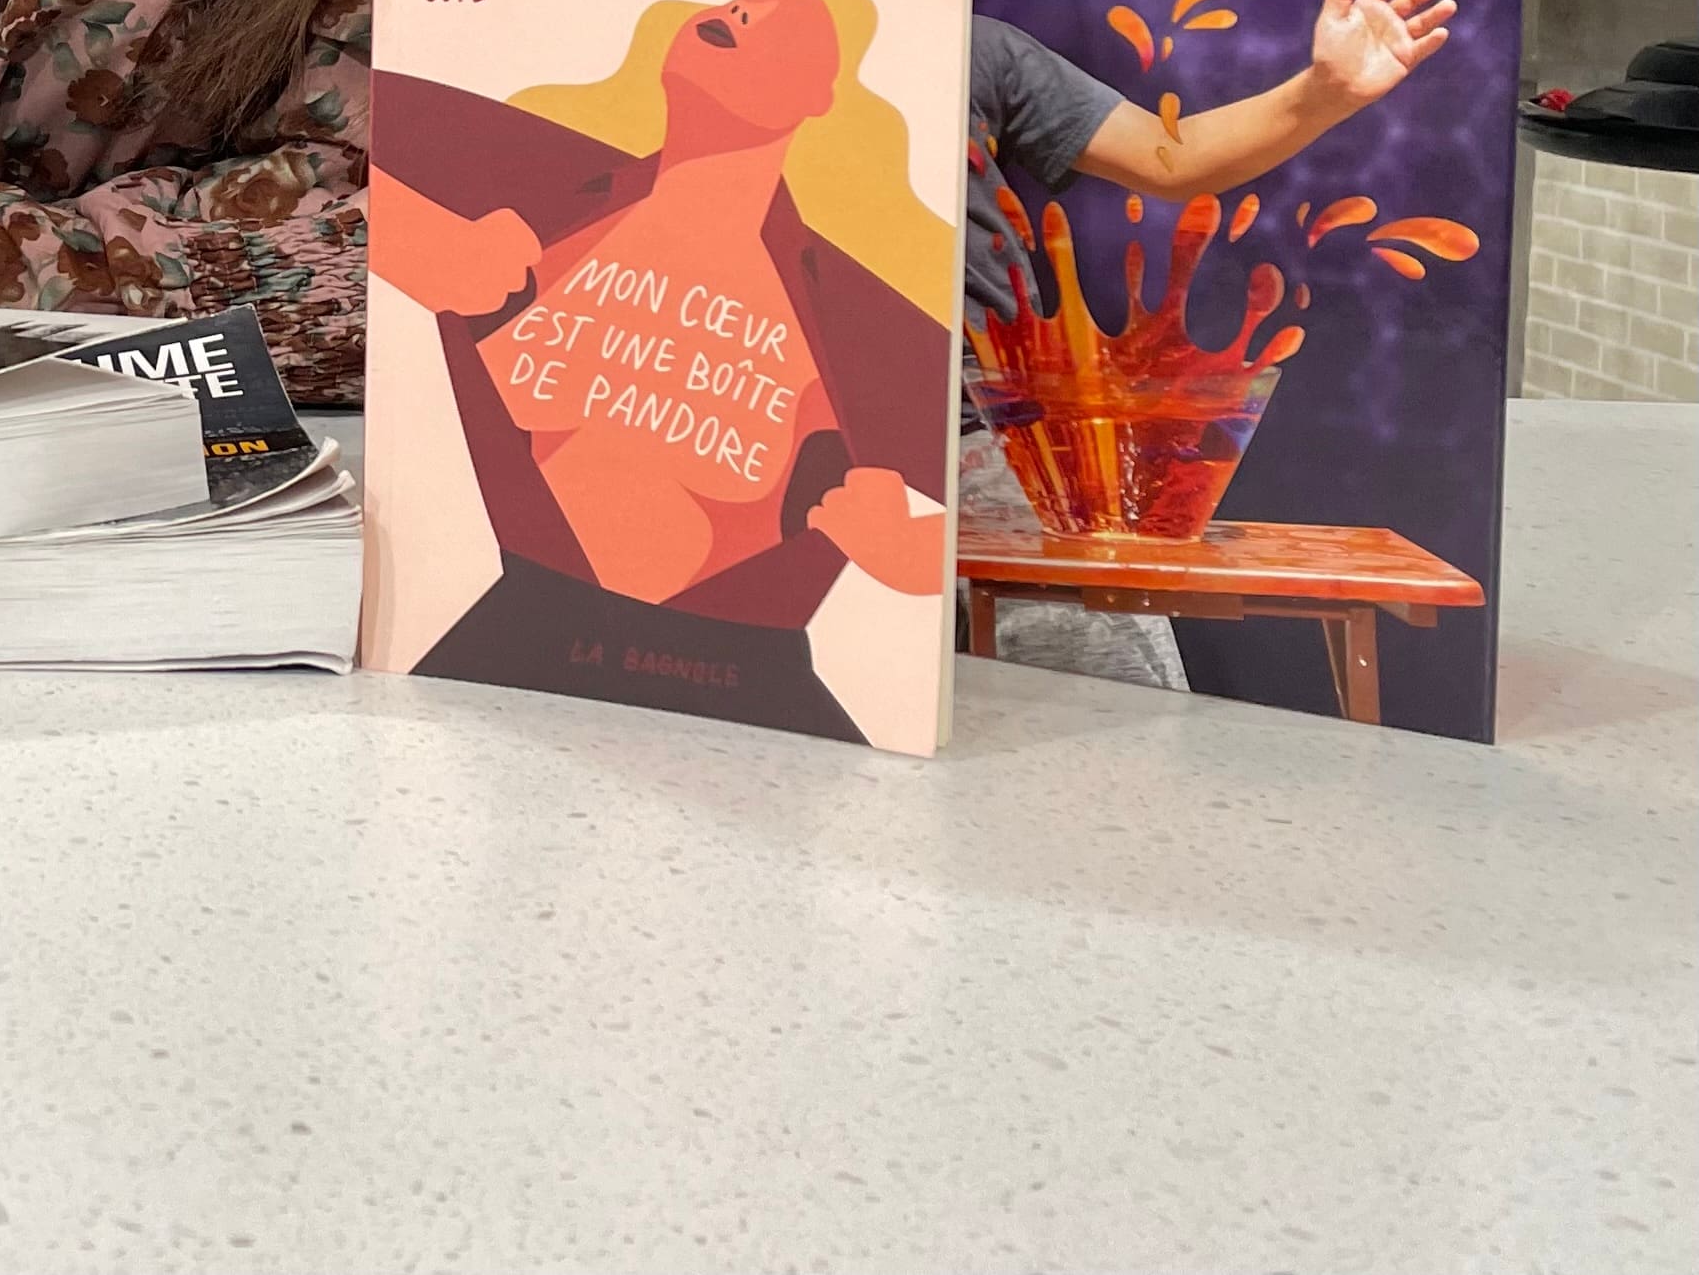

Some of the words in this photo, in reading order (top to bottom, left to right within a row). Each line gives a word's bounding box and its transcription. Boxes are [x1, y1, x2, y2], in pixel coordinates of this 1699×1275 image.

[511, 306, 594, 351] EST
[601, 324, 676, 373] UNE
[686, 352, 796, 424] BOÎTE
[563, 258, 669, 314] MON
[680, 284, 787, 362] CŒUR
[509, 352, 567, 401] DE
[583, 374, 769, 483] PANDORE
